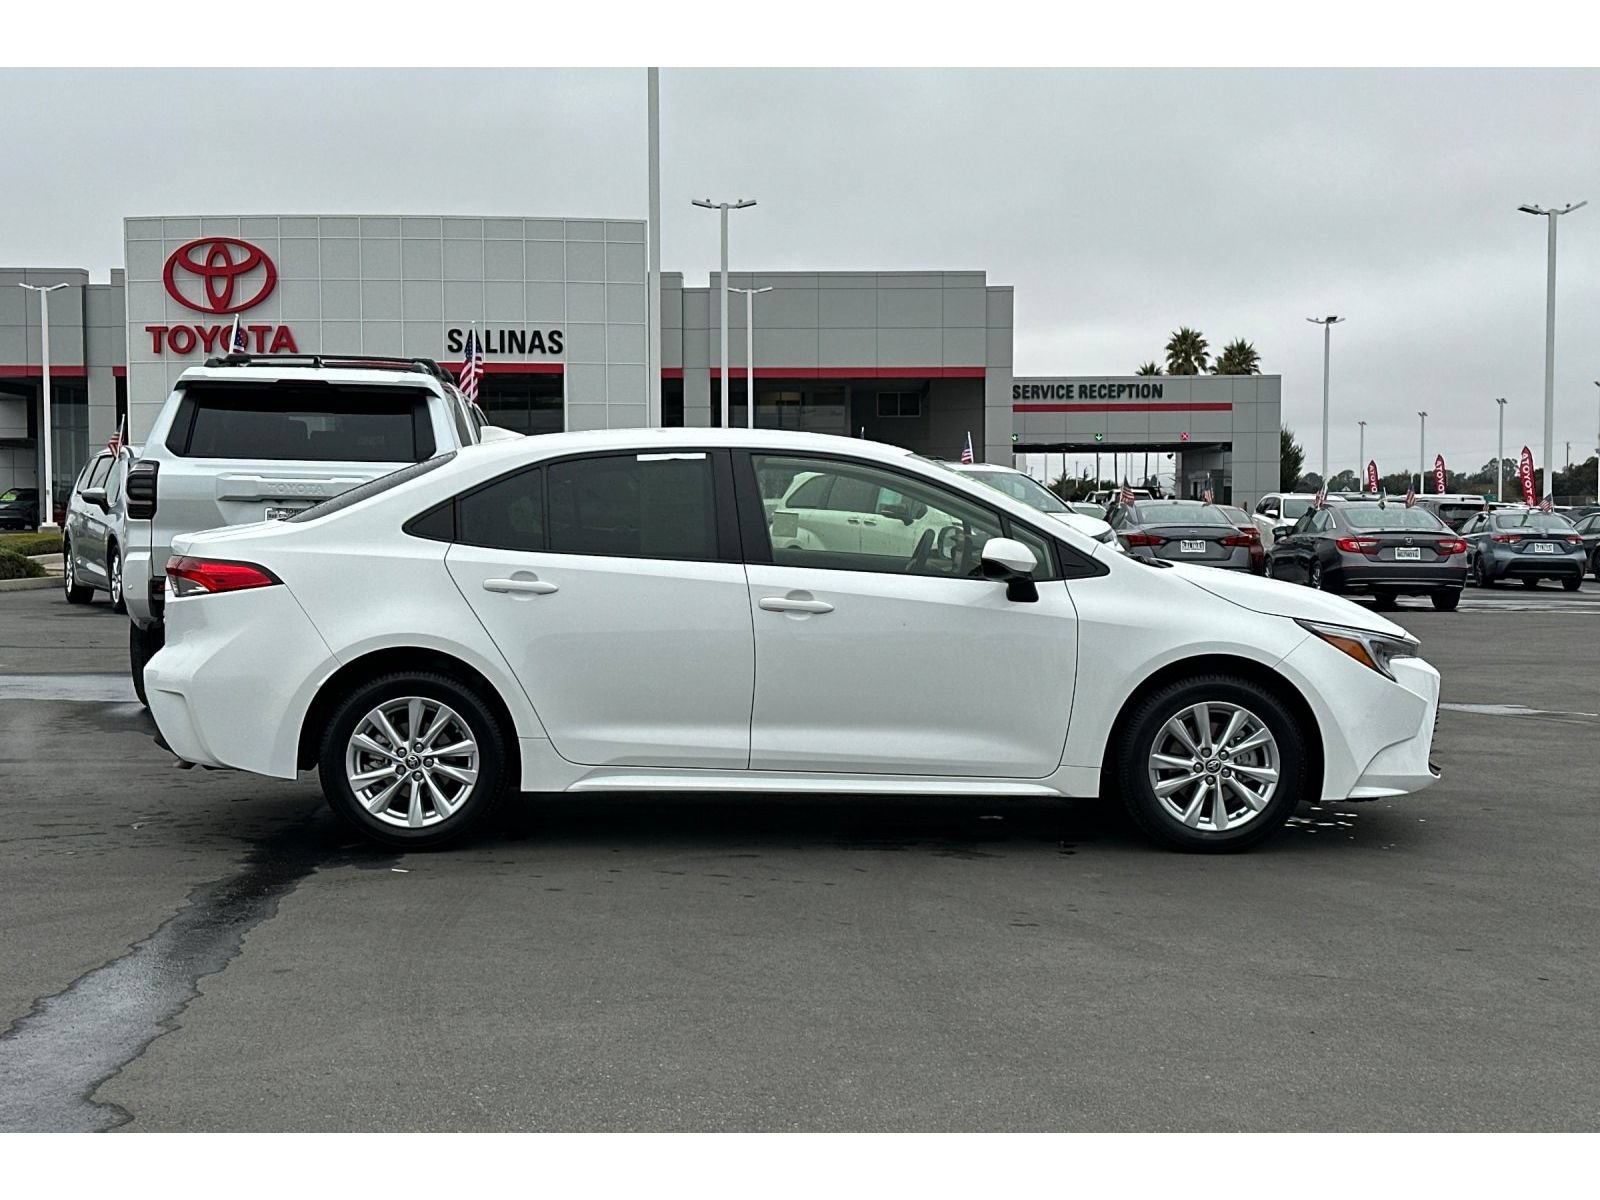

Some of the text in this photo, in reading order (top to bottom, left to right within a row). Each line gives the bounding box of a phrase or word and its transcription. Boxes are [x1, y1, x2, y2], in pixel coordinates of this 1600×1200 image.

[145, 324, 299, 354] TOYOTA
[1012, 383, 1163, 400] SERVICE RECEPTION
[267, 483, 325, 495] TOYOTA
